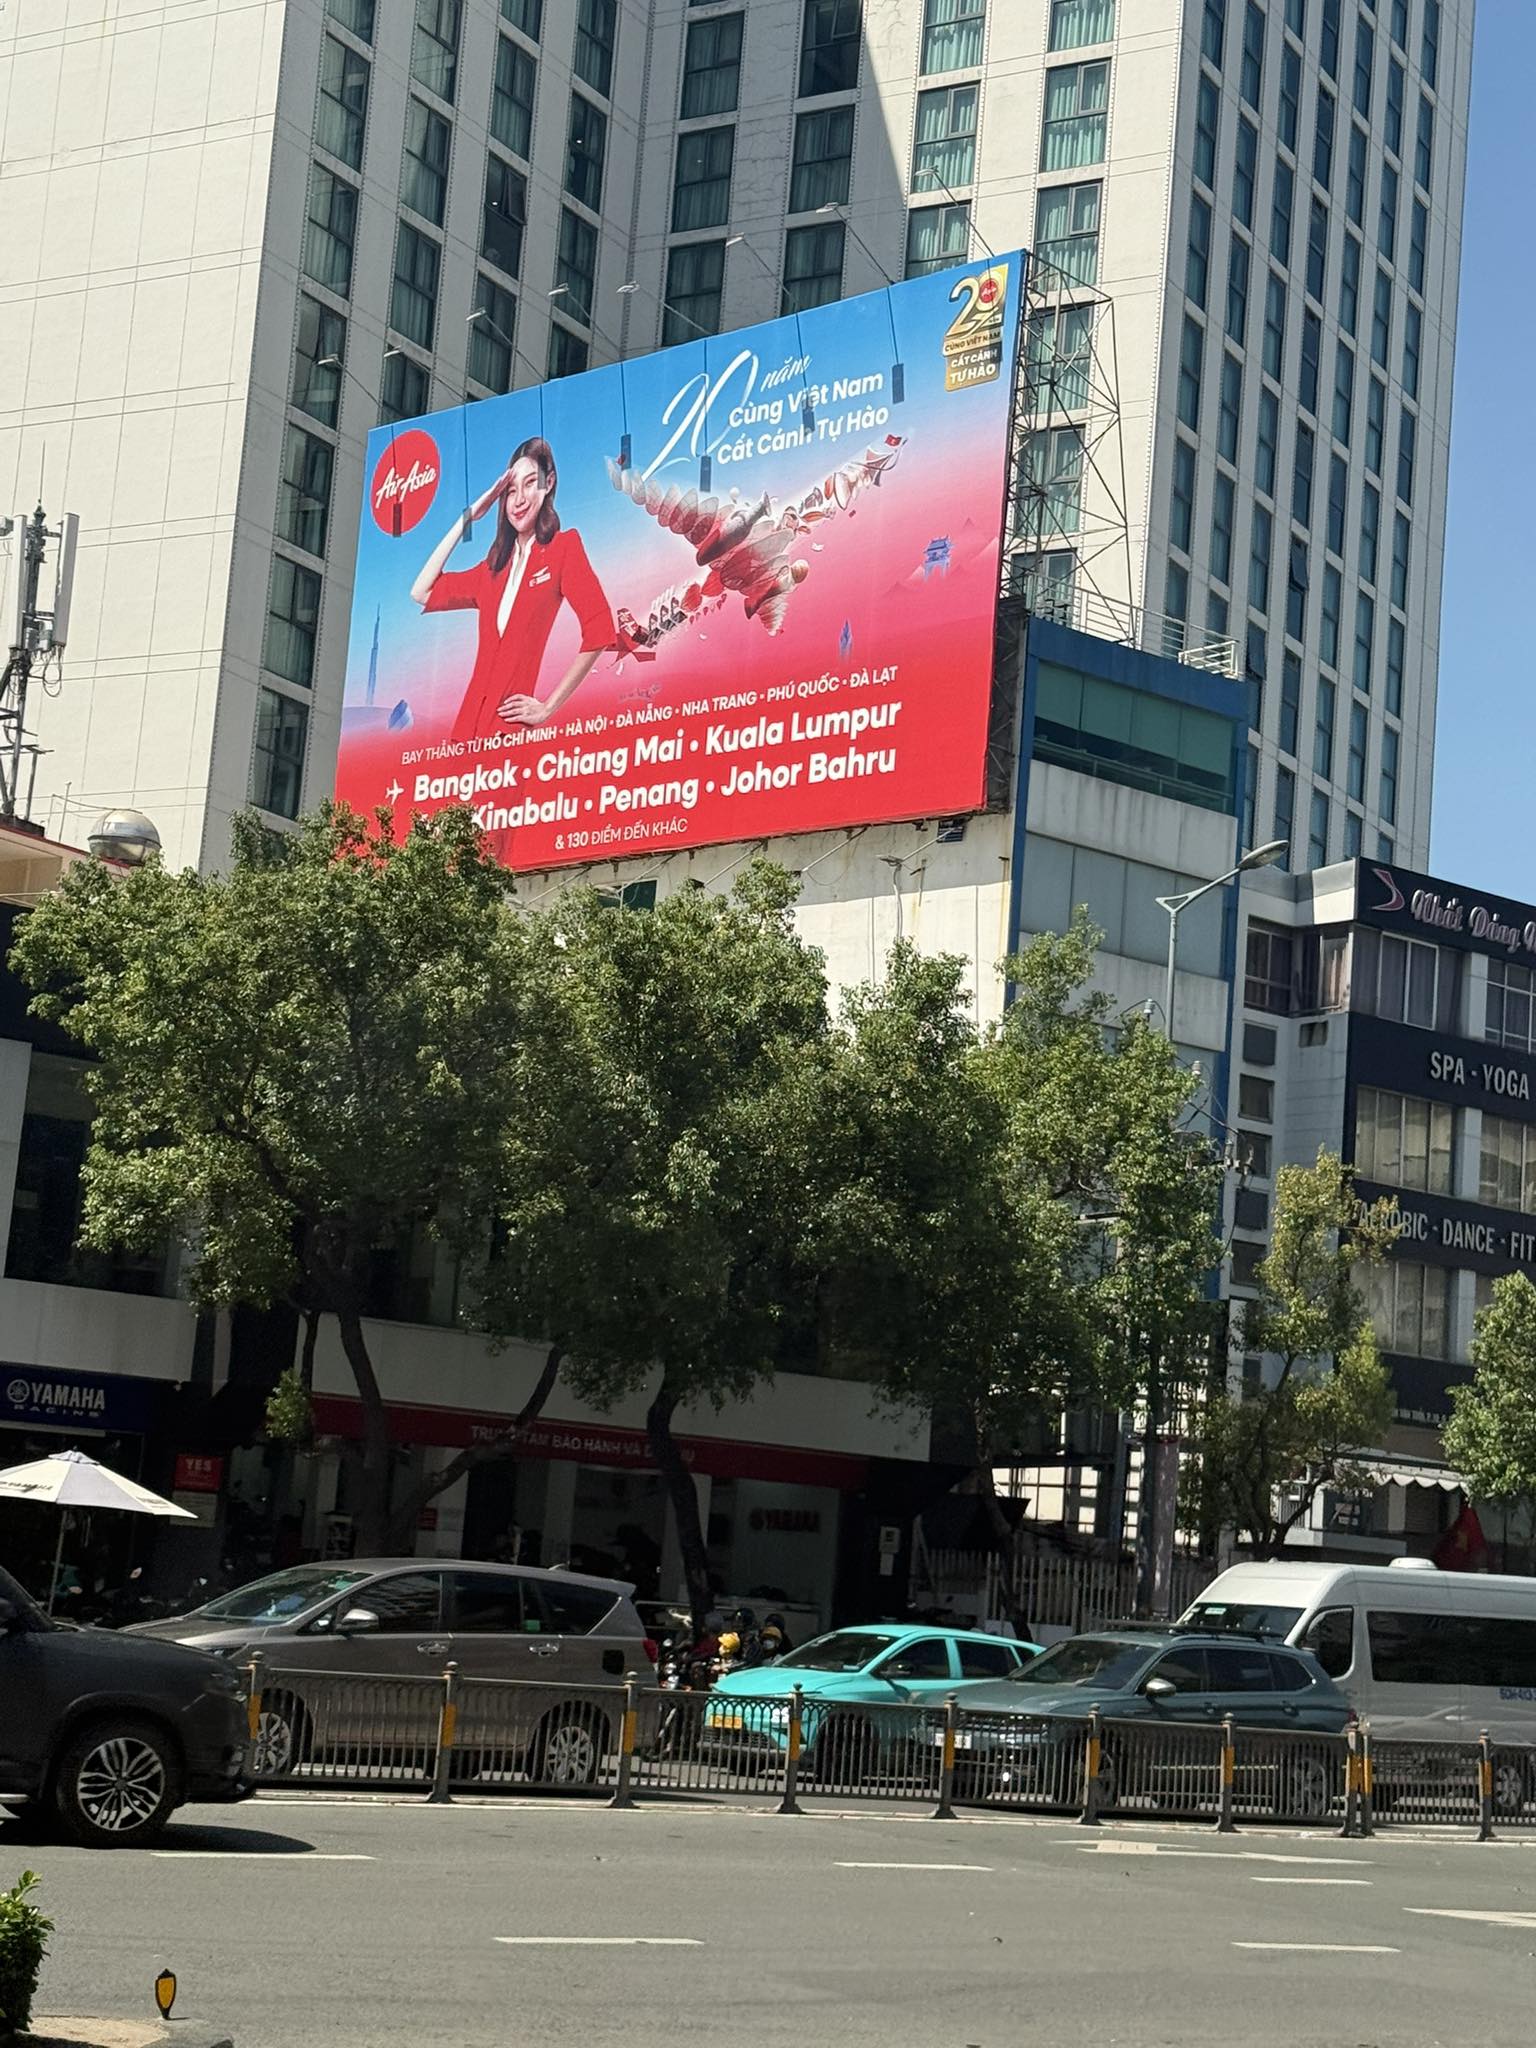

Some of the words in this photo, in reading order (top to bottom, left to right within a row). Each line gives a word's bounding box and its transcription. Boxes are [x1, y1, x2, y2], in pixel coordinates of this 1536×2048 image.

[760, 354, 813, 392] năm
[729, 400, 784, 428] Cùng
[788, 383, 828, 412] Việt
[832, 373, 884, 401] Nam
[716, 432, 754, 465] Cất
[757, 424, 812, 456] Cánh
[818, 415, 844, 443] Tự
[847, 405, 889, 433] Hào
[402, 749, 424, 766] BAY
[425, 739, 465, 761] THẲNG
[467, 735, 484, 754] TỪ
[483, 730, 502, 752] HỒ
[503, 727, 526, 748] CHÍ
[526, 726, 557, 745] MINH
[565, 718, 583, 737] HÀ
[585, 714, 608, 736] NỘI
[615, 708, 634, 728] ĐÀ
[682, 698, 710, 717] NHA
[712, 690, 758, 712] TRANG
[767, 682, 795, 702] PHÚ
[797, 672, 840, 698] QUỐC
[850, 668, 871, 688] ĐÀ
[873, 665, 899, 687] LẠT
[413, 759, 519, 801] Bangkok
[536, 746, 628, 782] Chiang
[634, 728, 684, 767] Mai
[705, 716, 784, 755] Kuala
[790, 701, 903, 741] Lumpur
[599, 777, 699, 815] Penang
[720, 761, 803, 797] Johor
[808, 747, 897, 784] Bahru
[554, 834, 566, 851] &
[566, 831, 589, 848] 130
[591, 823, 622, 846] ĐIỂM
[623, 820, 650, 840] ĐẾN
[651, 818, 689, 837] KHÁC
[1429, 1051, 1466, 1086] SPA
[1482, 1062, 1530, 1101] YOGA
[1442, 1218, 1496, 1255] DANCE
[31, 1381, 106, 1411] YAMAHA
